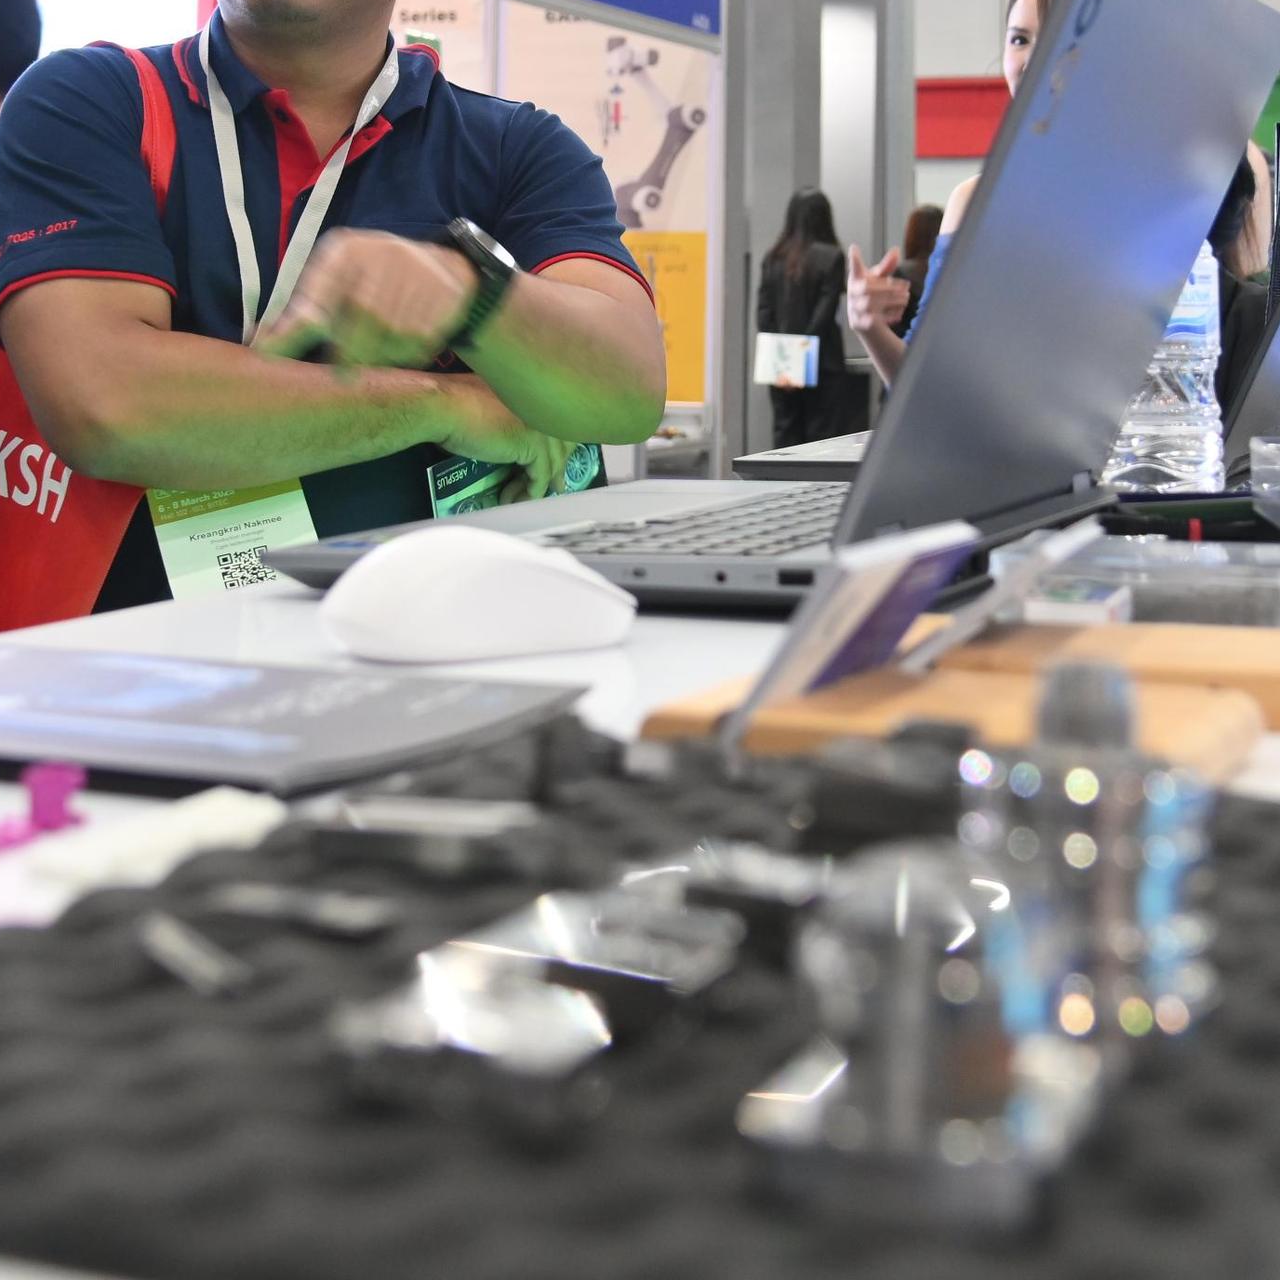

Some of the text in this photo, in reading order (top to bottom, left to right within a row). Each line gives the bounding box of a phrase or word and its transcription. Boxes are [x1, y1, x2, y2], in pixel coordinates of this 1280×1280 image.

[45, 219, 78, 235] 2017
[437, 466, 468, 490] ARESPLUS
[181, 494, 210, 507] March
[189, 525, 242, 542] Kreangkrai
[243, 516, 283, 531] Nakmee
